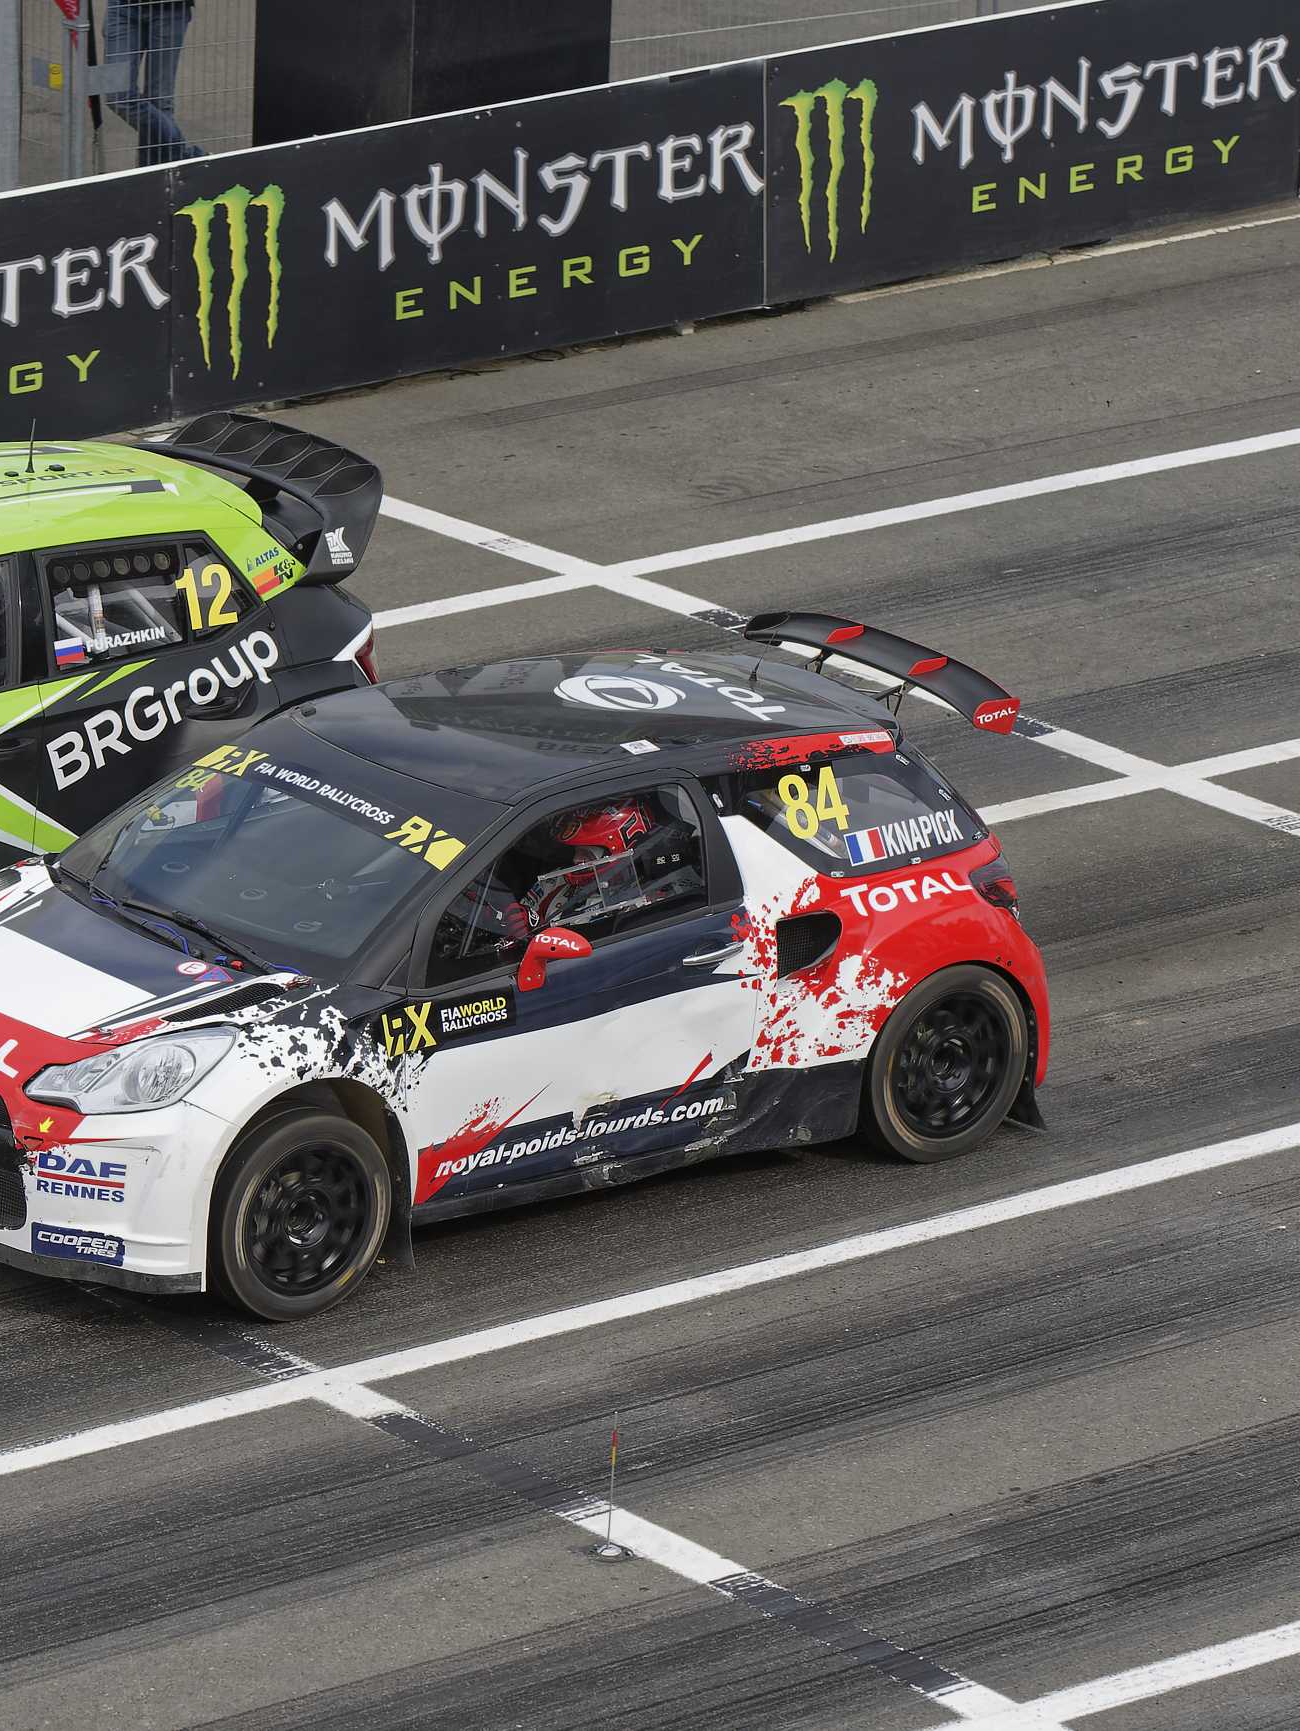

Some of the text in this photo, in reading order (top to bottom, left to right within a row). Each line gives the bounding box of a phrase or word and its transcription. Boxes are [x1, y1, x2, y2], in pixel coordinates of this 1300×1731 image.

[910, 34, 1297, 170] MONSTER
[320, 120, 766, 272] MONSTER
[971, 135, 1240, 214] ENERGY
[395, 235, 704, 321] ENERGY
[255, 547, 280, 567] ALTAS
[175, 563, 239, 631] 12
[46, 630, 279, 792] BRGroup
[634, 653, 786, 722] TOTAL
[976, 706, 1017, 725] TOTAL
[254, 761, 396, 826] FIA WORLD RALLYCROSS
[778, 766, 850, 839] 84
[882, 809, 964, 857] KNAPICK
[840, 872, 975, 917] TOTAL
[534, 933, 580, 952] TOTAL
[442, 1009, 509, 1033] RALLYCROSS
[38, 1152, 127, 1178] DAF
[36, 1179, 125, 1203] RENNES
[37, 1230, 119, 1251] COOPER
[76, 1245, 118, 1258] TIRES
